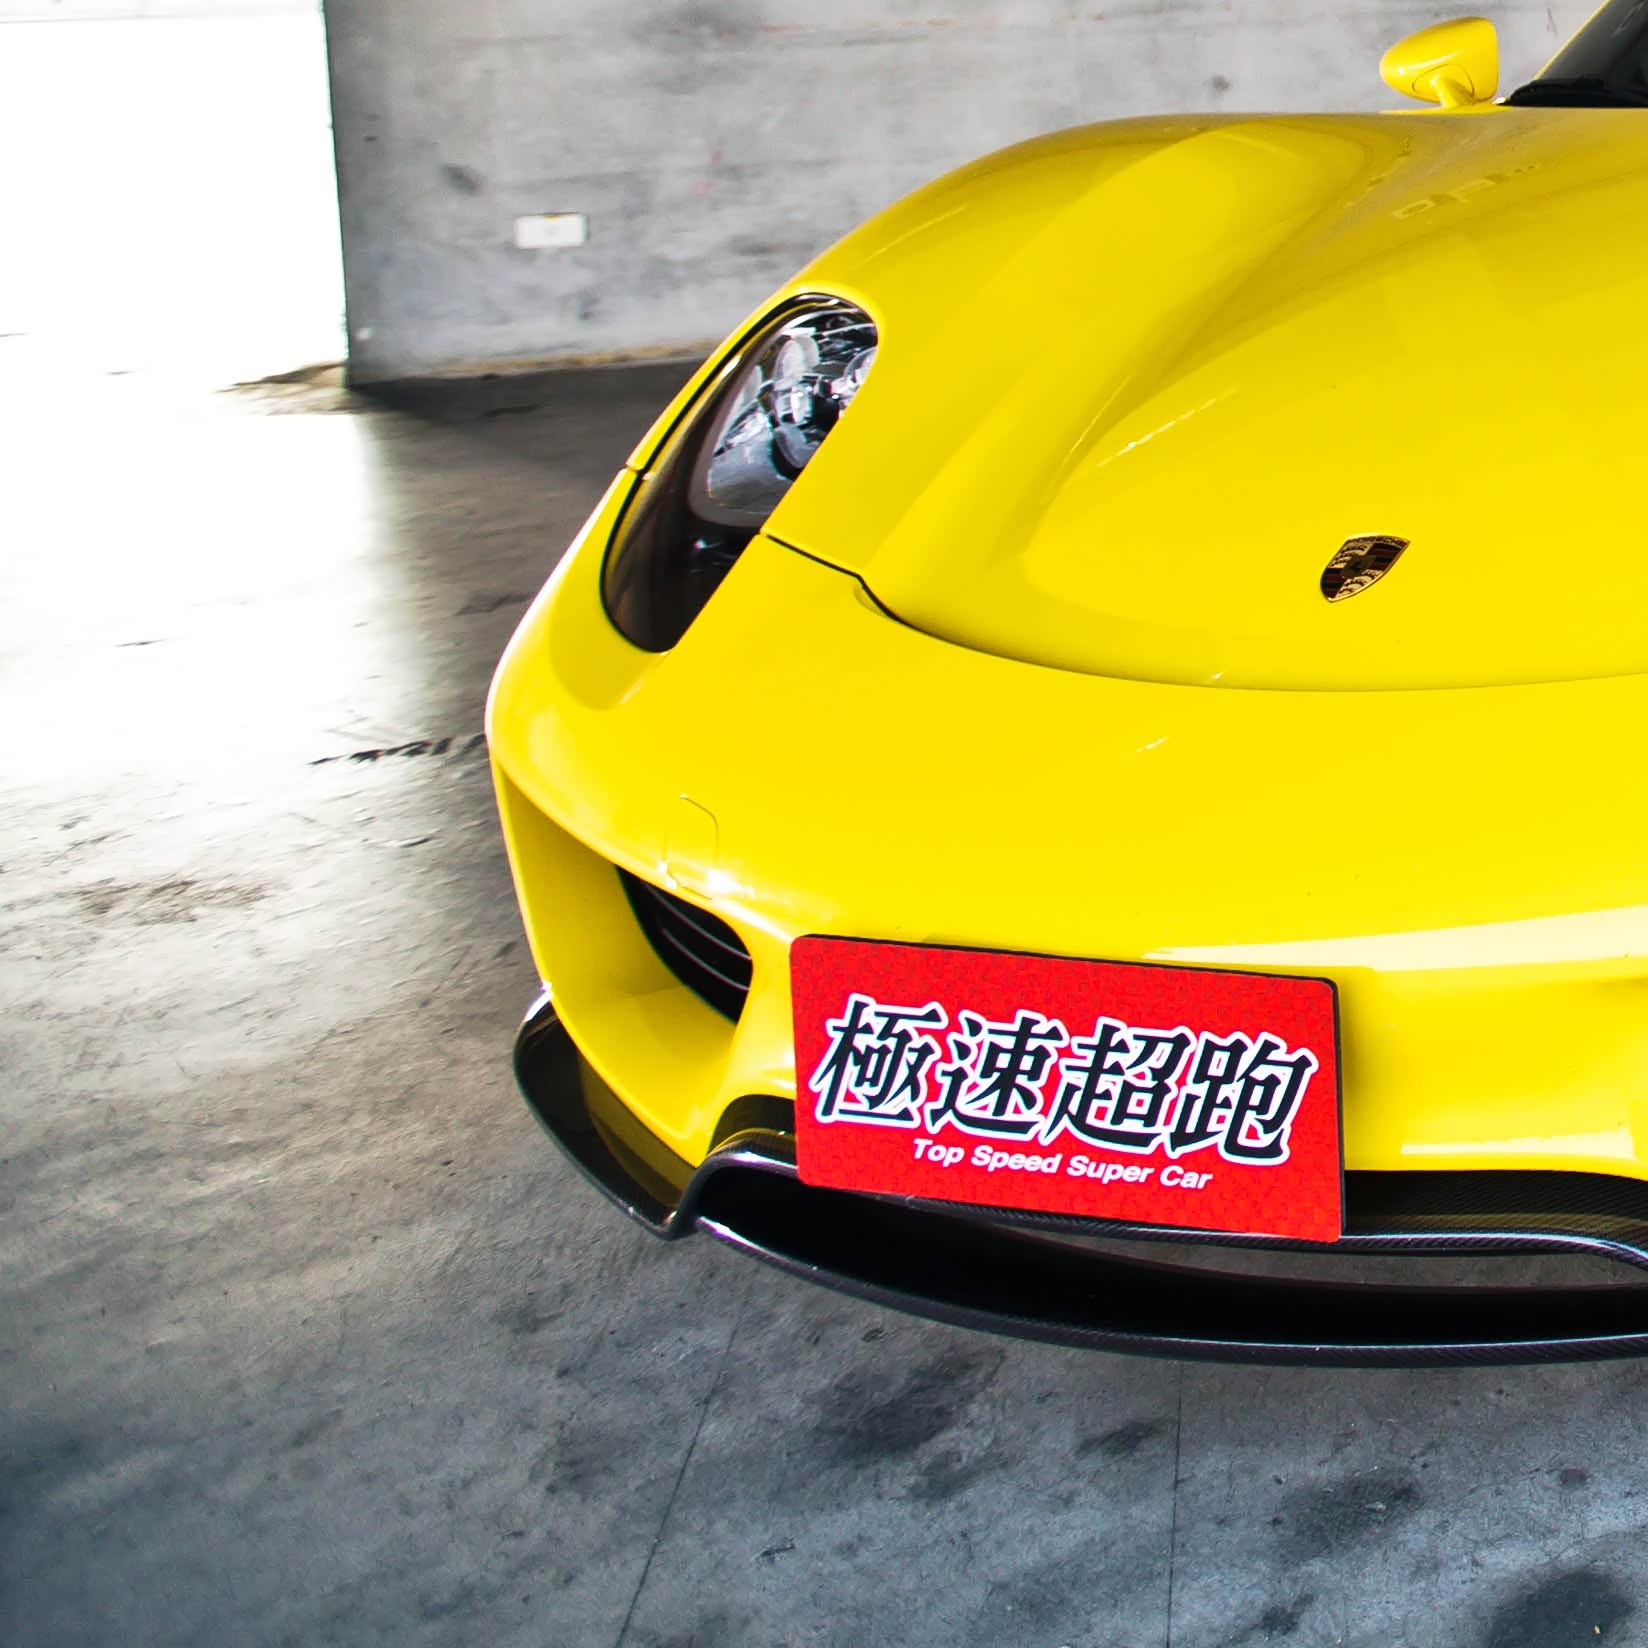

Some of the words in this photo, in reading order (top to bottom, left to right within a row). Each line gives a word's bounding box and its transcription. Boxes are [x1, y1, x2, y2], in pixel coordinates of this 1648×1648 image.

[811, 994, 1319, 1164] 極速超跑
[912, 1138, 964, 1167] Top
[971, 1145, 1062, 1172] Speed
[1066, 1155, 1154, 1184] Super
[1160, 1165, 1213, 1189] Car
